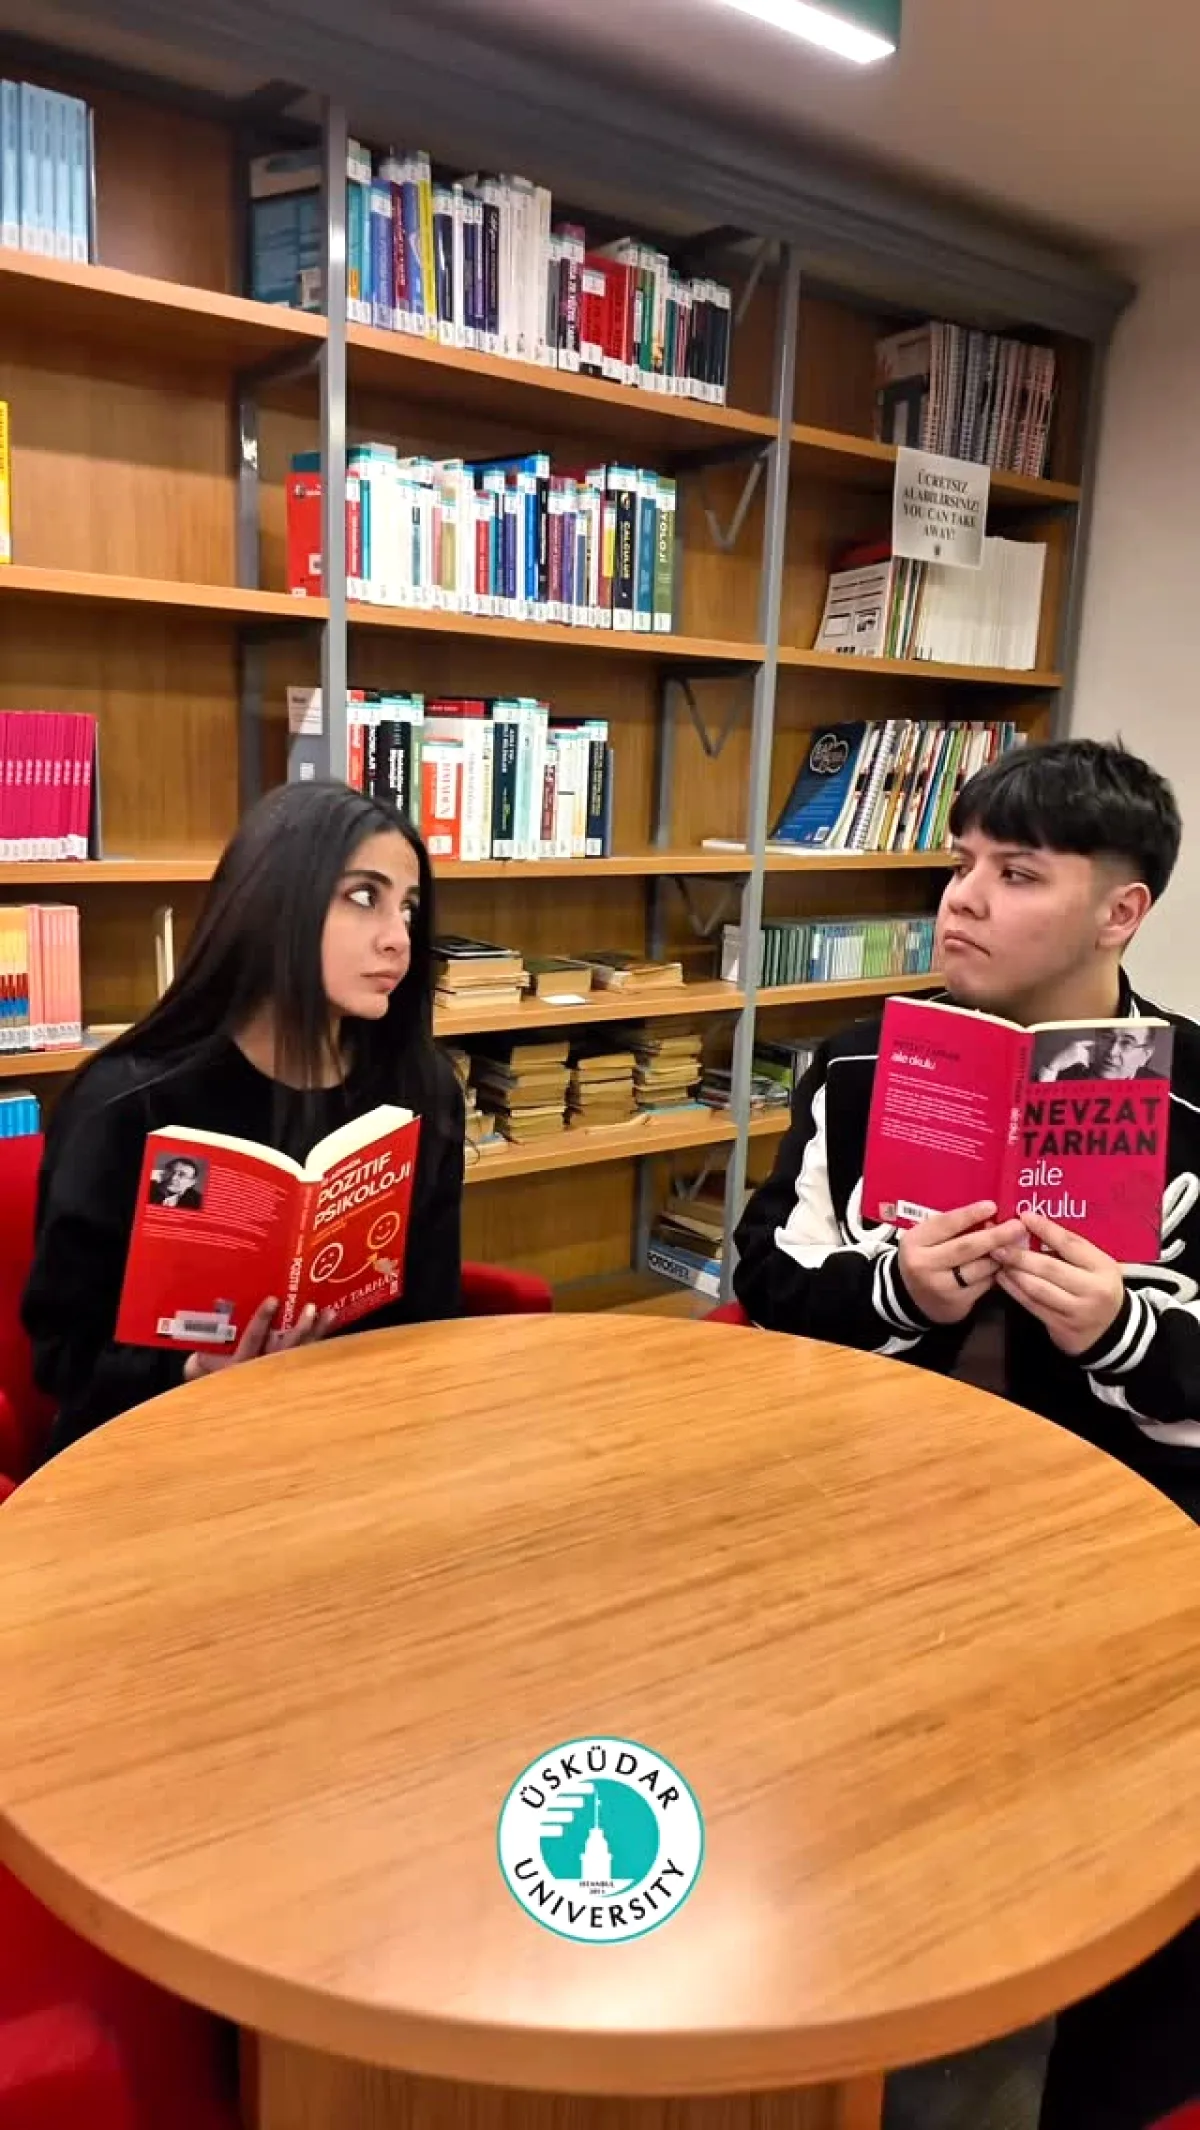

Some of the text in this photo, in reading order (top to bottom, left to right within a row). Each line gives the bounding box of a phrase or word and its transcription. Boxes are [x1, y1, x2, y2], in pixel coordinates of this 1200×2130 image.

[903, 503, 975, 527] YOU CAN TAKE
[1023, 1097, 1161, 1126] NEVZAT
[1022, 1130, 1156, 1157] TARHAN
[1018, 1159, 1063, 1187] aile
[1016, 1191, 1086, 1218] okulu
